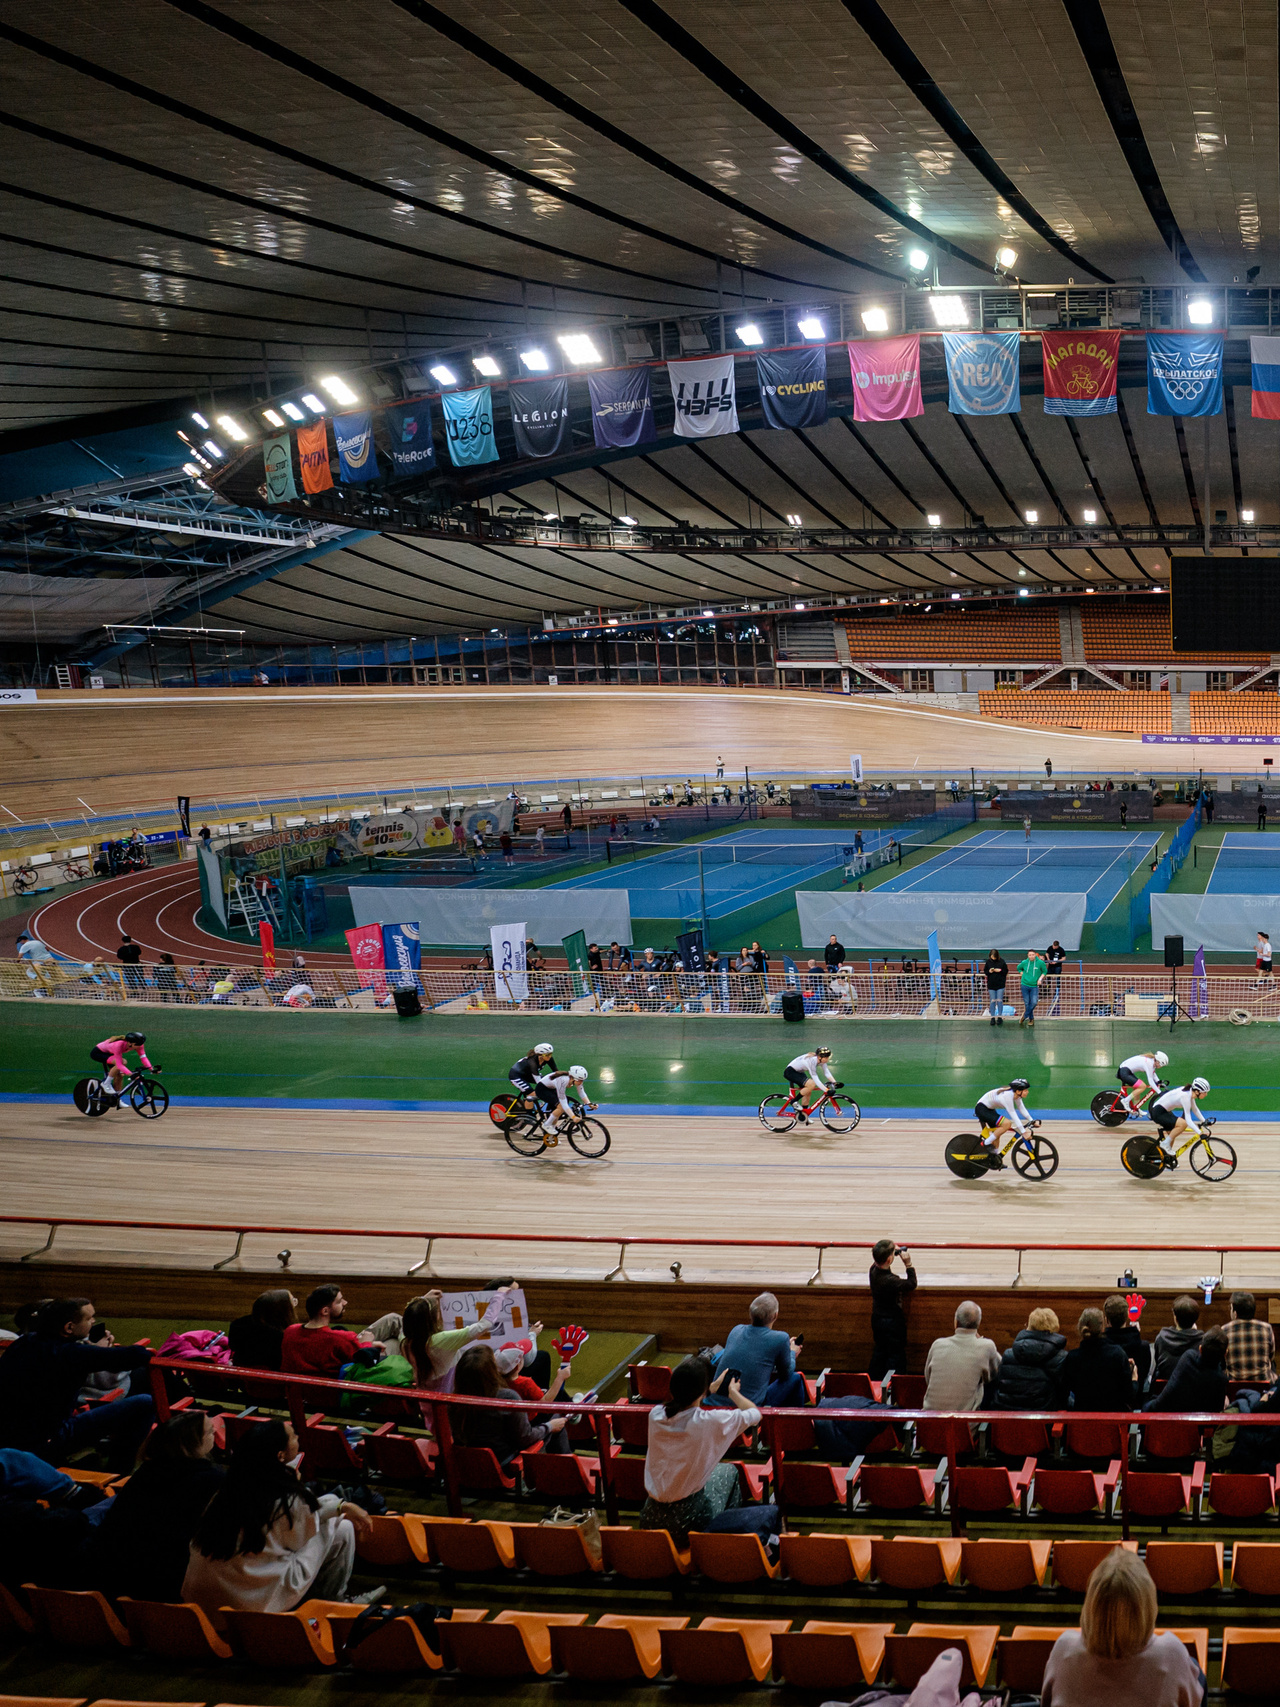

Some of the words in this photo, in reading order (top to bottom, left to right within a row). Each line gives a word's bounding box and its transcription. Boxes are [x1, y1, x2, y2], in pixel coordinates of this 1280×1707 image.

[1046, 341, 1115, 370] МАГАДАН
[872, 369, 918, 387] Impulse
[963, 362, 1003, 387] RCA
[1153, 367, 1217, 379] КРЫЛАТСКОЕ
[777, 380, 825, 396] CYCLING
[514, 407, 568, 423] LEGION
[446, 413, 492, 441] U238
[365, 821, 404, 836] tennis
